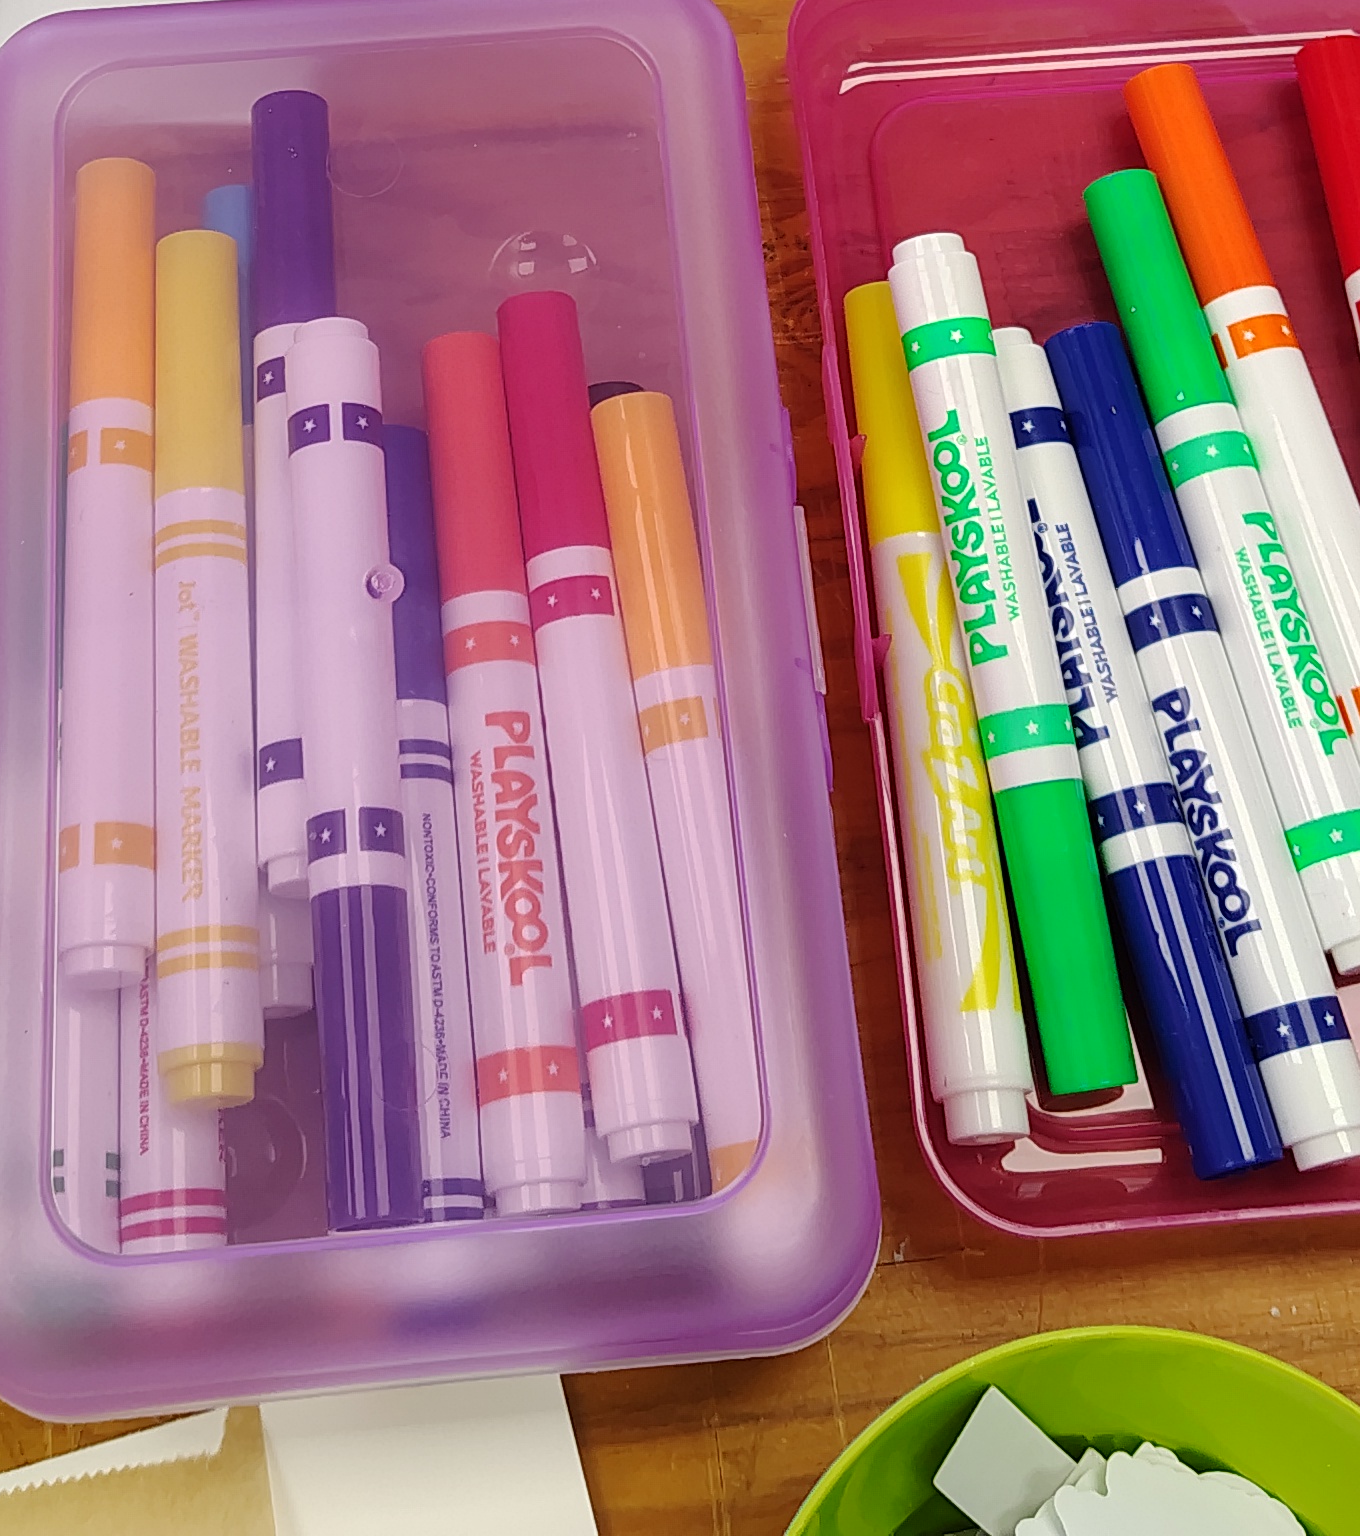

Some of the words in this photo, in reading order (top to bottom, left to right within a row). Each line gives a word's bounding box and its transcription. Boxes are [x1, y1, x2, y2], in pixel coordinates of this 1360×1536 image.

[926, 408, 1008, 667] PLAYSKOOL
[1241, 511, 1349, 757] PLAYSKOOL
[175, 634, 204, 775] WASHABLE
[1153, 686, 1257, 958] PLAYSKOOL
[181, 786, 204, 901] MARKER
[485, 712, 554, 987] PLAYSKOOL
